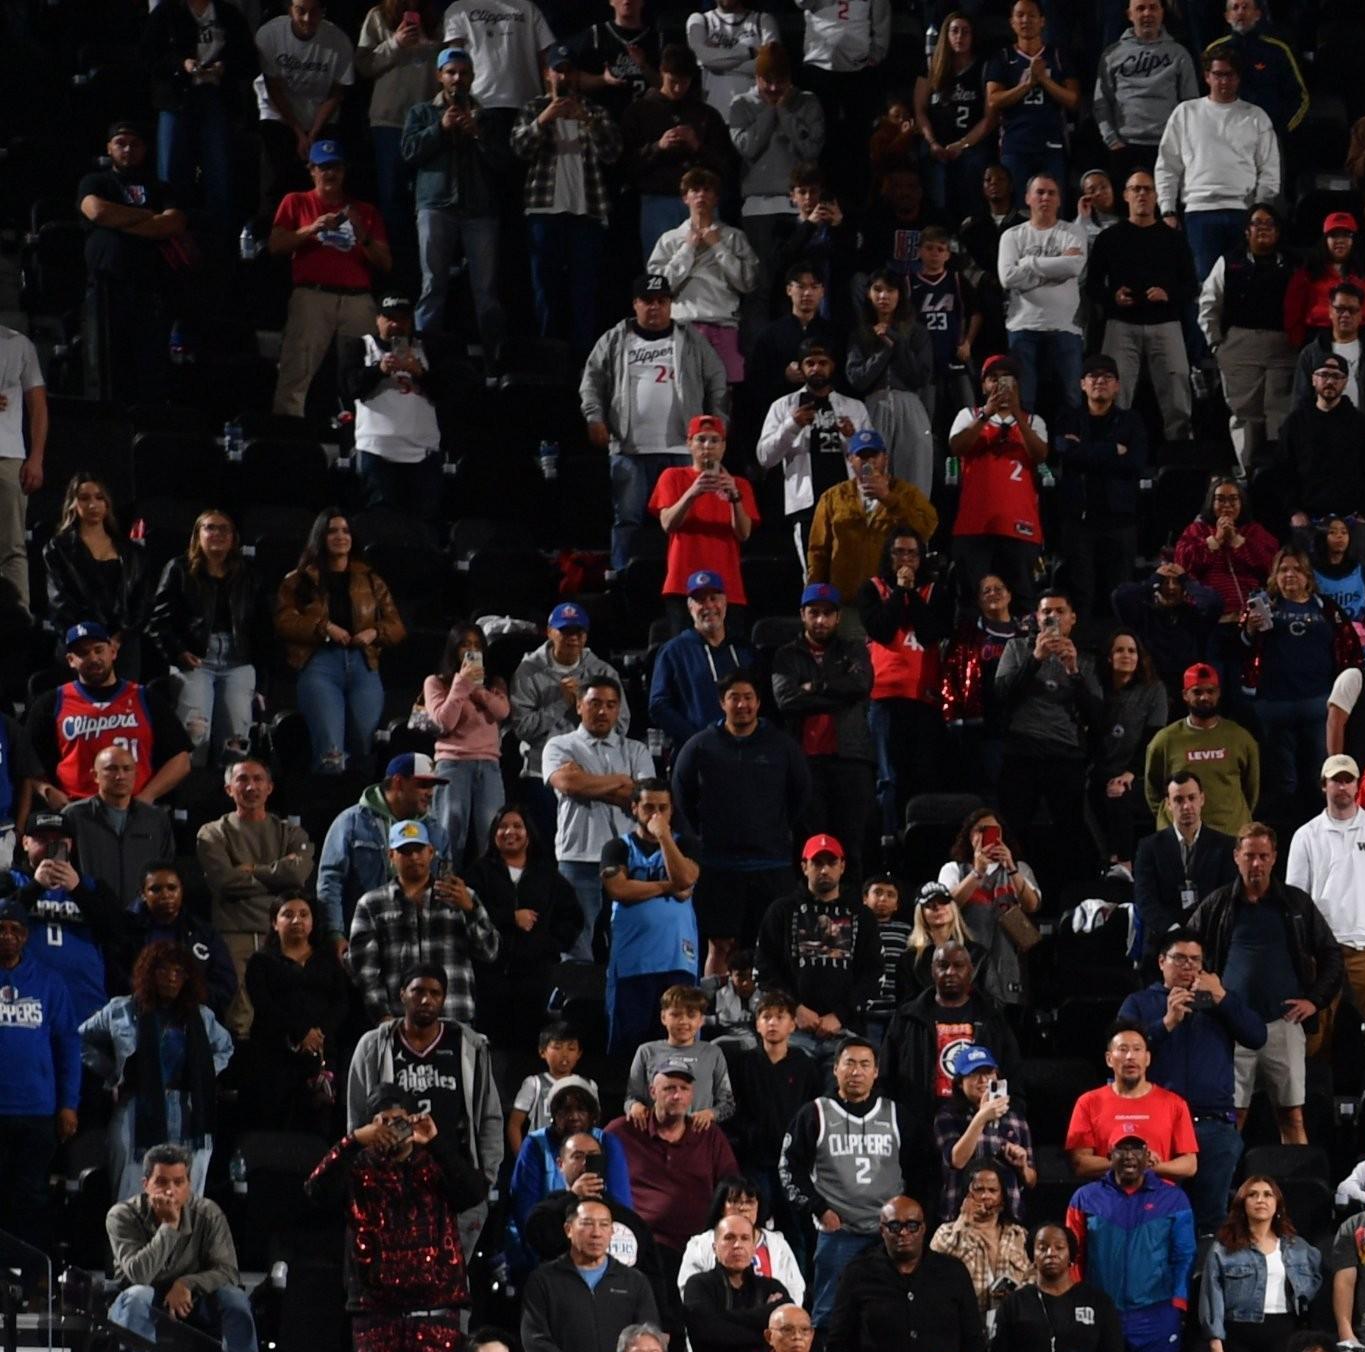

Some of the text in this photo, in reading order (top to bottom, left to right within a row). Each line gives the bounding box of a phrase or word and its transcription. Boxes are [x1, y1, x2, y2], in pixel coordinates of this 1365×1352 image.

[1120, 52, 1172, 78] Clips
[956, 105, 970, 128] 2
[926, 312, 948, 331] 23
[627, 345, 674, 365] Clipper
[1009, 459, 1024, 481] 2
[61, 708, 139, 741] Clippers
[193, 942, 211, 962] C
[0, 1000, 44, 1029] PPERS
[829, 1132, 894, 1158] CLIPPERS
[855, 1157, 873, 1185] 2
